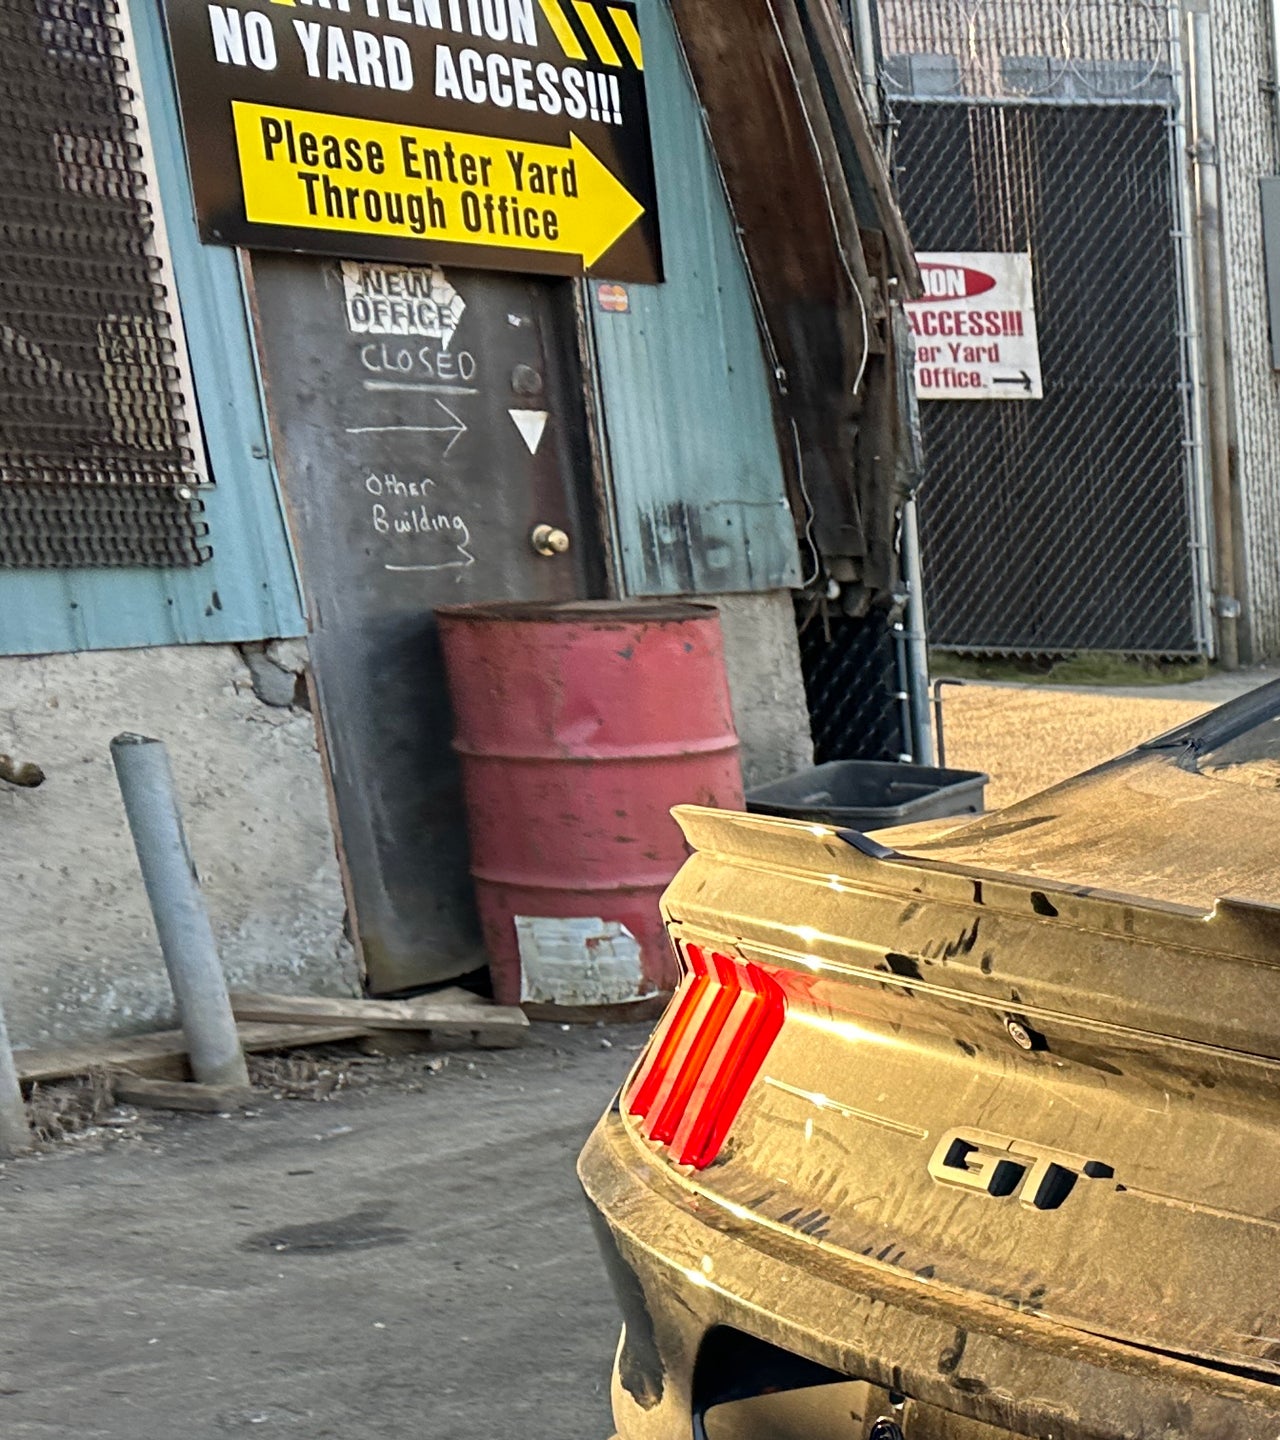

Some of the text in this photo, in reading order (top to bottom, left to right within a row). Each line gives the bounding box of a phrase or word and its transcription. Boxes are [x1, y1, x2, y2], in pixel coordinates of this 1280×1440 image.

[208, 4, 623, 125] NO YARD ACCESS!!!
[260, 116, 578, 199] Please Enter Yard
[298, 171, 559, 241] Through Office
[361, 268, 432, 298] NEW
[351, 295, 453, 330] OFFICE
[361, 342, 477, 380] CLOSED
[948, 343, 1000, 363] Yard
[373, 503, 470, 547] Building
[927, 1126, 1114, 1211] GT
